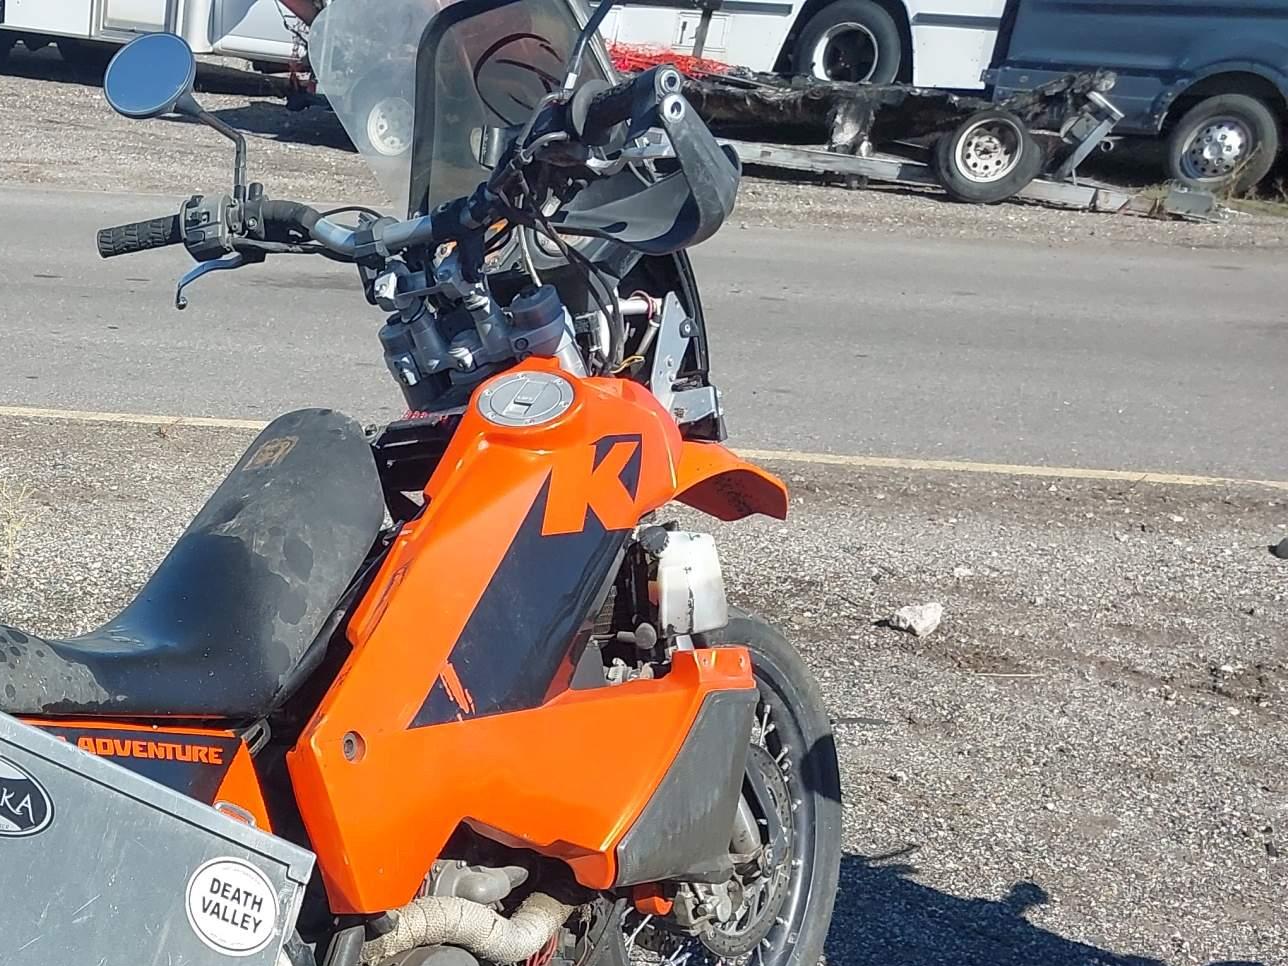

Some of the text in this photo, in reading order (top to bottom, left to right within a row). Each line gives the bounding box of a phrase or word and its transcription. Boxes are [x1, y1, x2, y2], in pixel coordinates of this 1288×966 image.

[77, 736, 224, 765] ADVENTURE
[209, 877, 264, 913] DEATH
[201, 895, 263, 934] VALLEY
